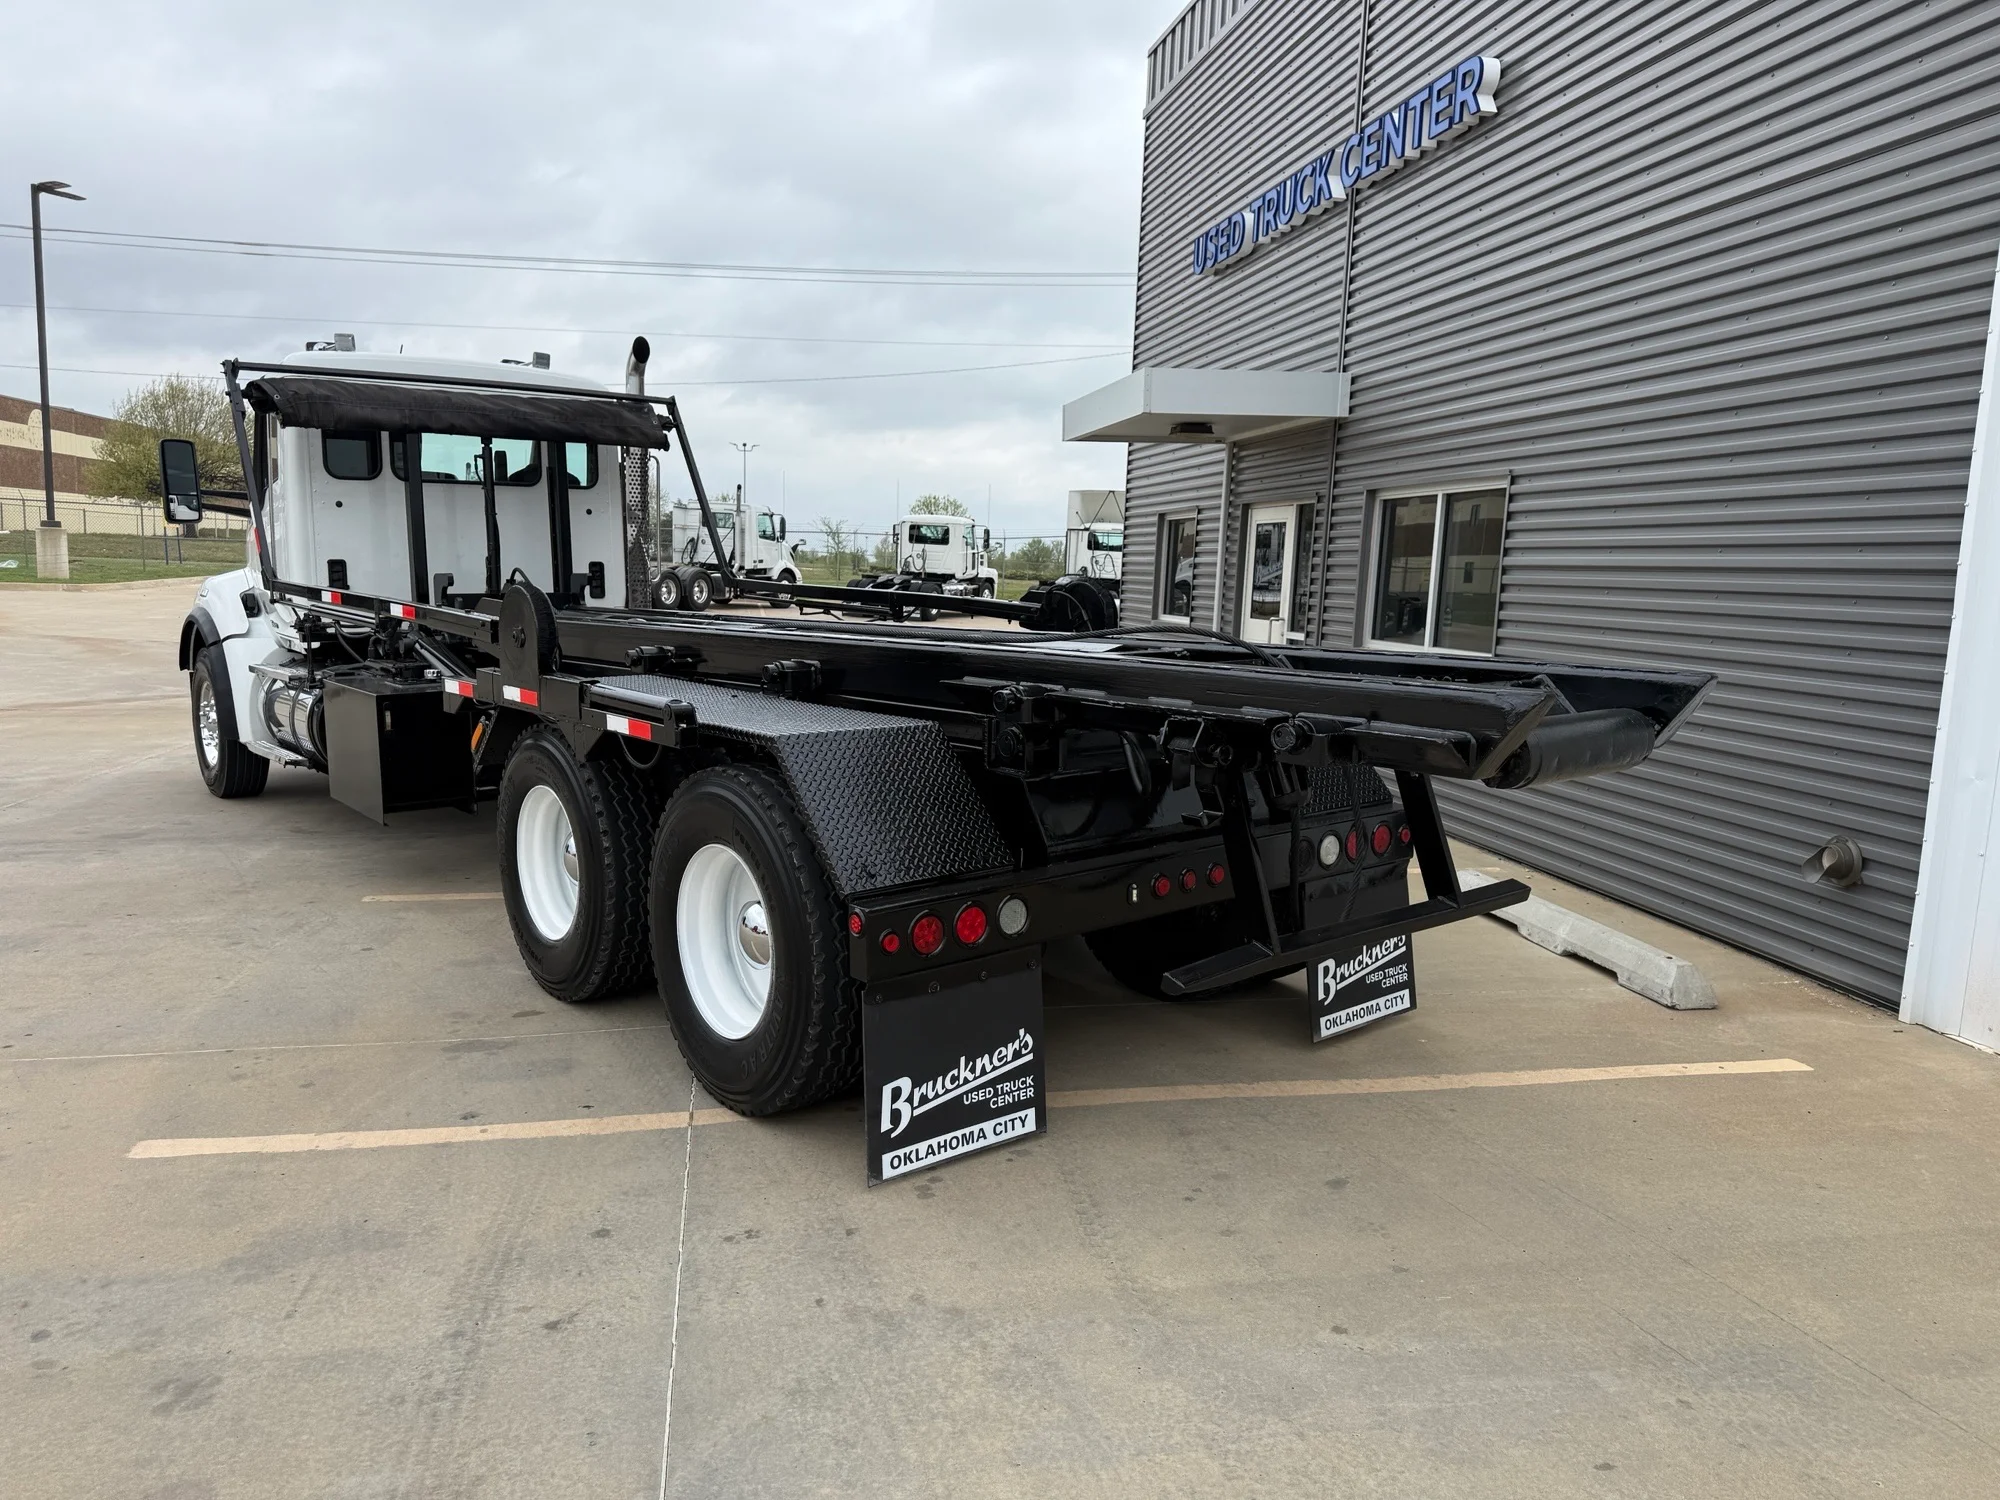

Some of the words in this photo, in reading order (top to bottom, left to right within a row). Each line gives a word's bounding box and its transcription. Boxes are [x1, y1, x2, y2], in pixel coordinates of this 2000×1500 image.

[1193, 211, 1246, 275] USED
[1250, 149, 1336, 244] TRUCK
[1339, 55, 1486, 189] CENTER
[1365, 971, 1384, 984] USED
[1384, 962, 1408, 978] TRUCK
[1381, 972, 1409, 988] CENTER
[1324, 1002, 1382, 1031] OKLAHOMA
[1384, 993, 1406, 1010] CITY
[880, 1027, 1034, 1139] Bruckner's
[963, 1088, 994, 1105] USED
[996, 1074, 1035, 1095] TRUCK
[989, 1087, 1035, 1109] CENTER
[889, 1127, 988, 1170] OKLAHOMA
[992, 1113, 1029, 1137] CITY
